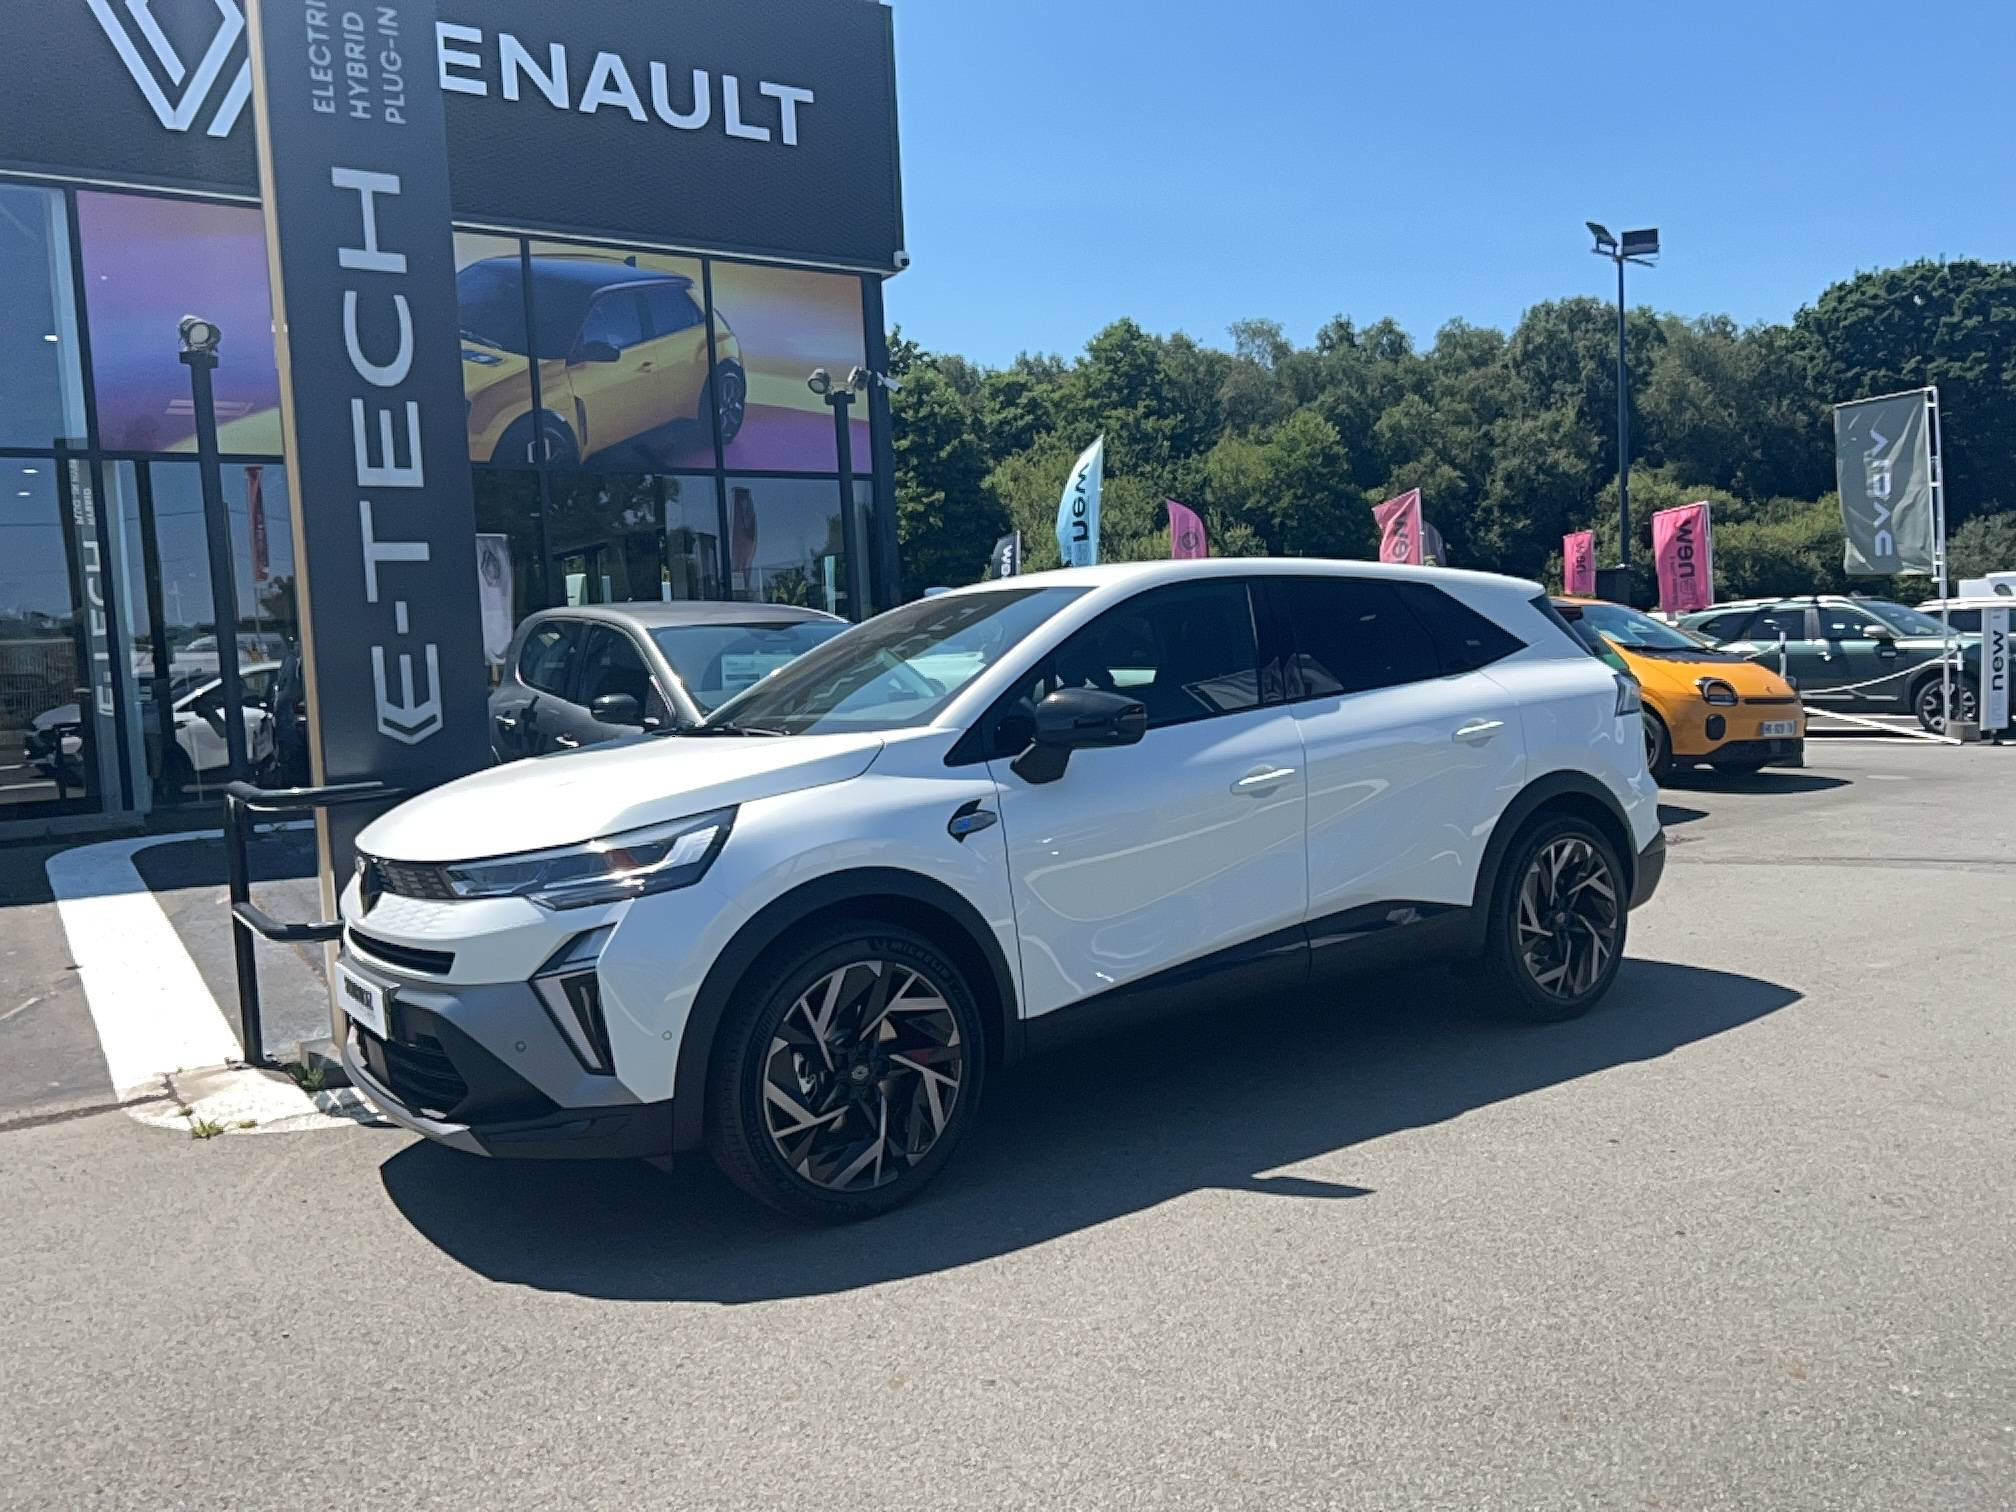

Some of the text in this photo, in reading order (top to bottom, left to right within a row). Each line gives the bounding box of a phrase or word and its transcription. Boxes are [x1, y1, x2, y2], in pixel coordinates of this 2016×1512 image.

[342, 11, 371, 119] HYBRID
[376, 6, 406, 125] PLUG-IN
[331, 166, 444, 745] E-TECH
